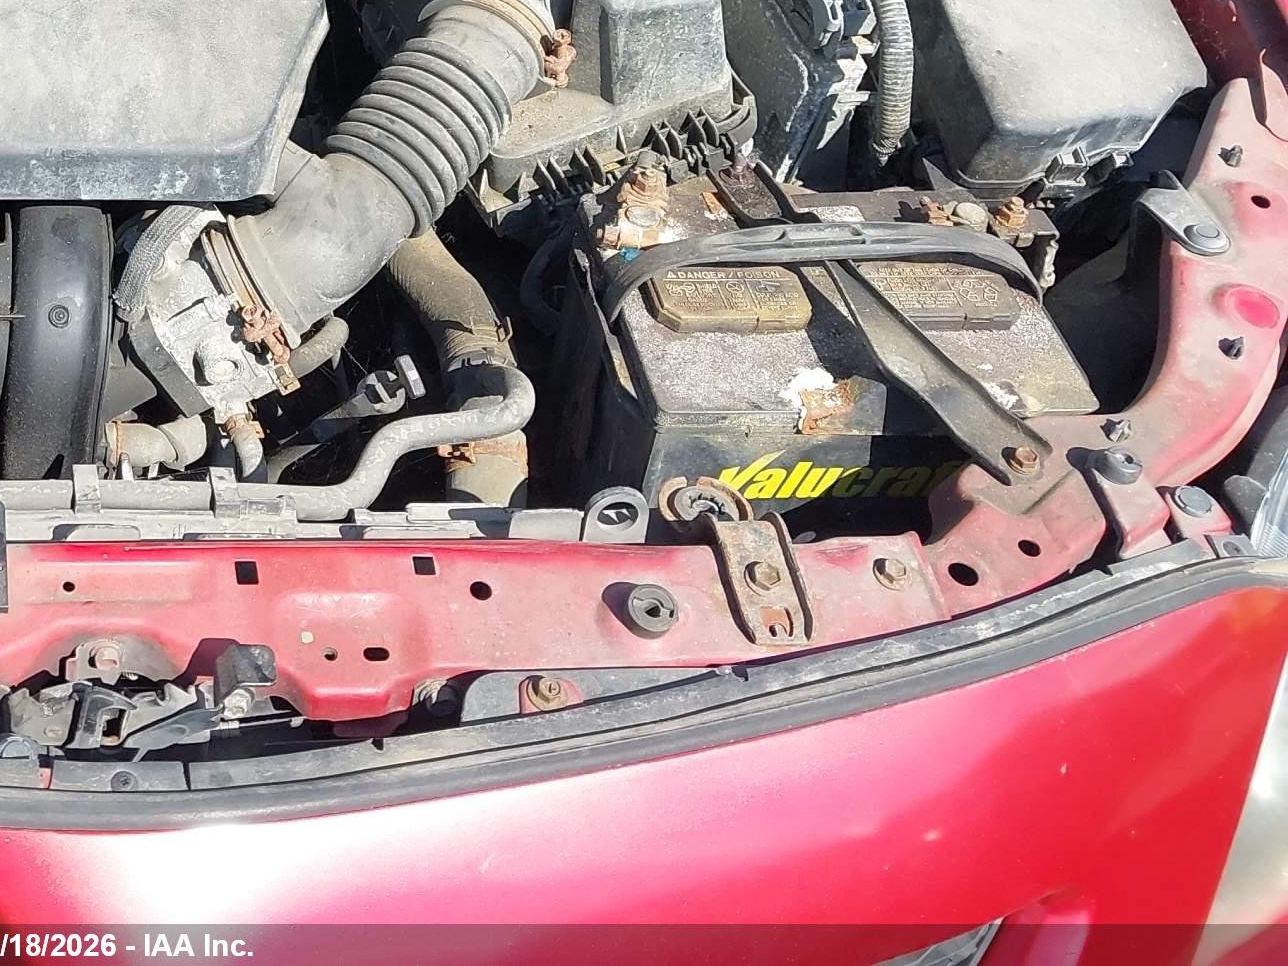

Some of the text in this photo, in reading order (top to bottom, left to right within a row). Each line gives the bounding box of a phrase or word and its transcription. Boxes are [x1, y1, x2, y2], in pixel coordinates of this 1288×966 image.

[678, 270, 725, 279] DANGER
[736, 270, 780, 279] POISON
[716, 449, 965, 499] Valucraf
